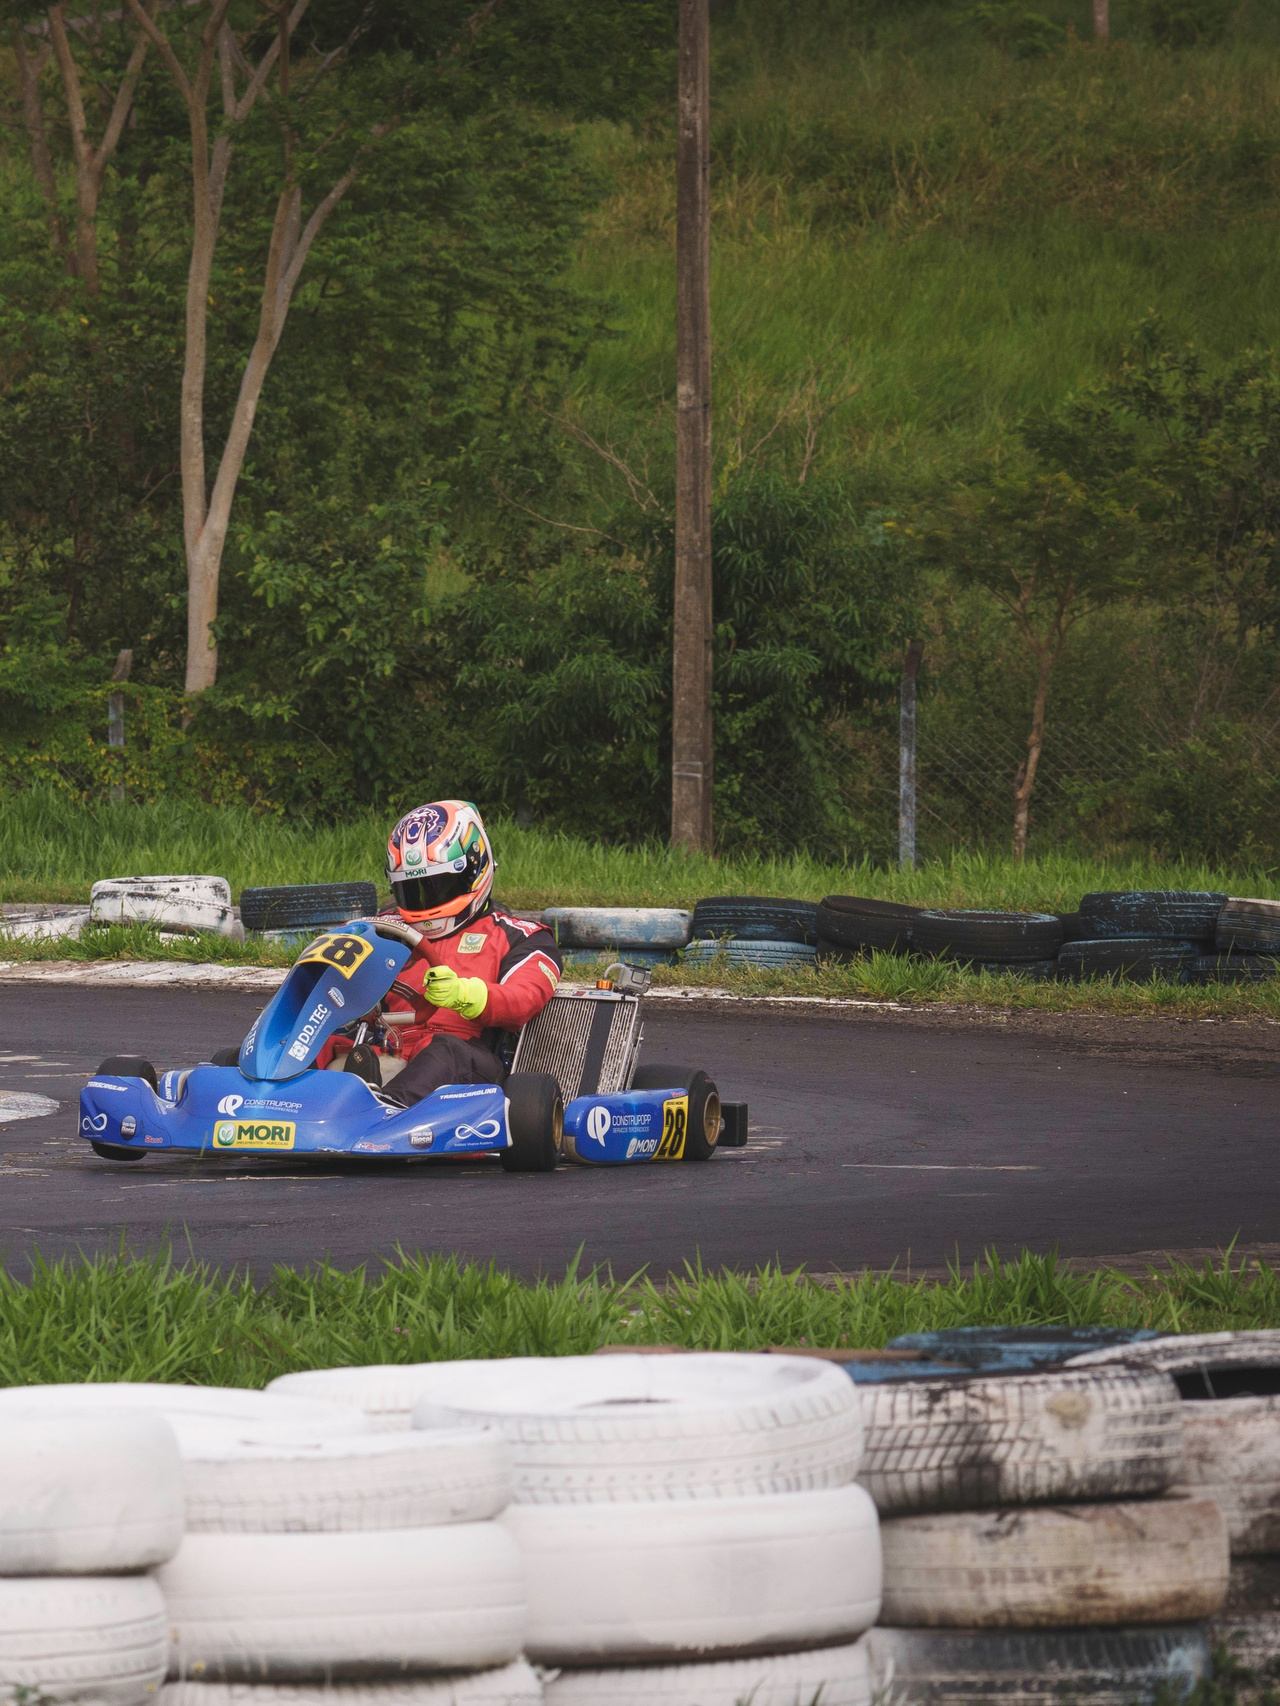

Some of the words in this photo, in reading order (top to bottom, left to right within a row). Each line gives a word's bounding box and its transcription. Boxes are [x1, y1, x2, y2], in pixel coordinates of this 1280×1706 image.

[405, 867, 427, 878] MORI
[300, 937, 364, 969] 28
[298, 1003, 328, 1044] DD.TEC
[439, 1087, 497, 1100] TRANSCAROLINA
[244, 1098, 303, 1109] CONSTRUPOPP
[612, 1114, 651, 1126] CONSTRUPOPP
[237, 1125, 291, 1141] MORI
[411, 1135, 432, 1144] Diesel
[657, 1108, 685, 1157] 28
[635, 1138, 658, 1153] MORI
